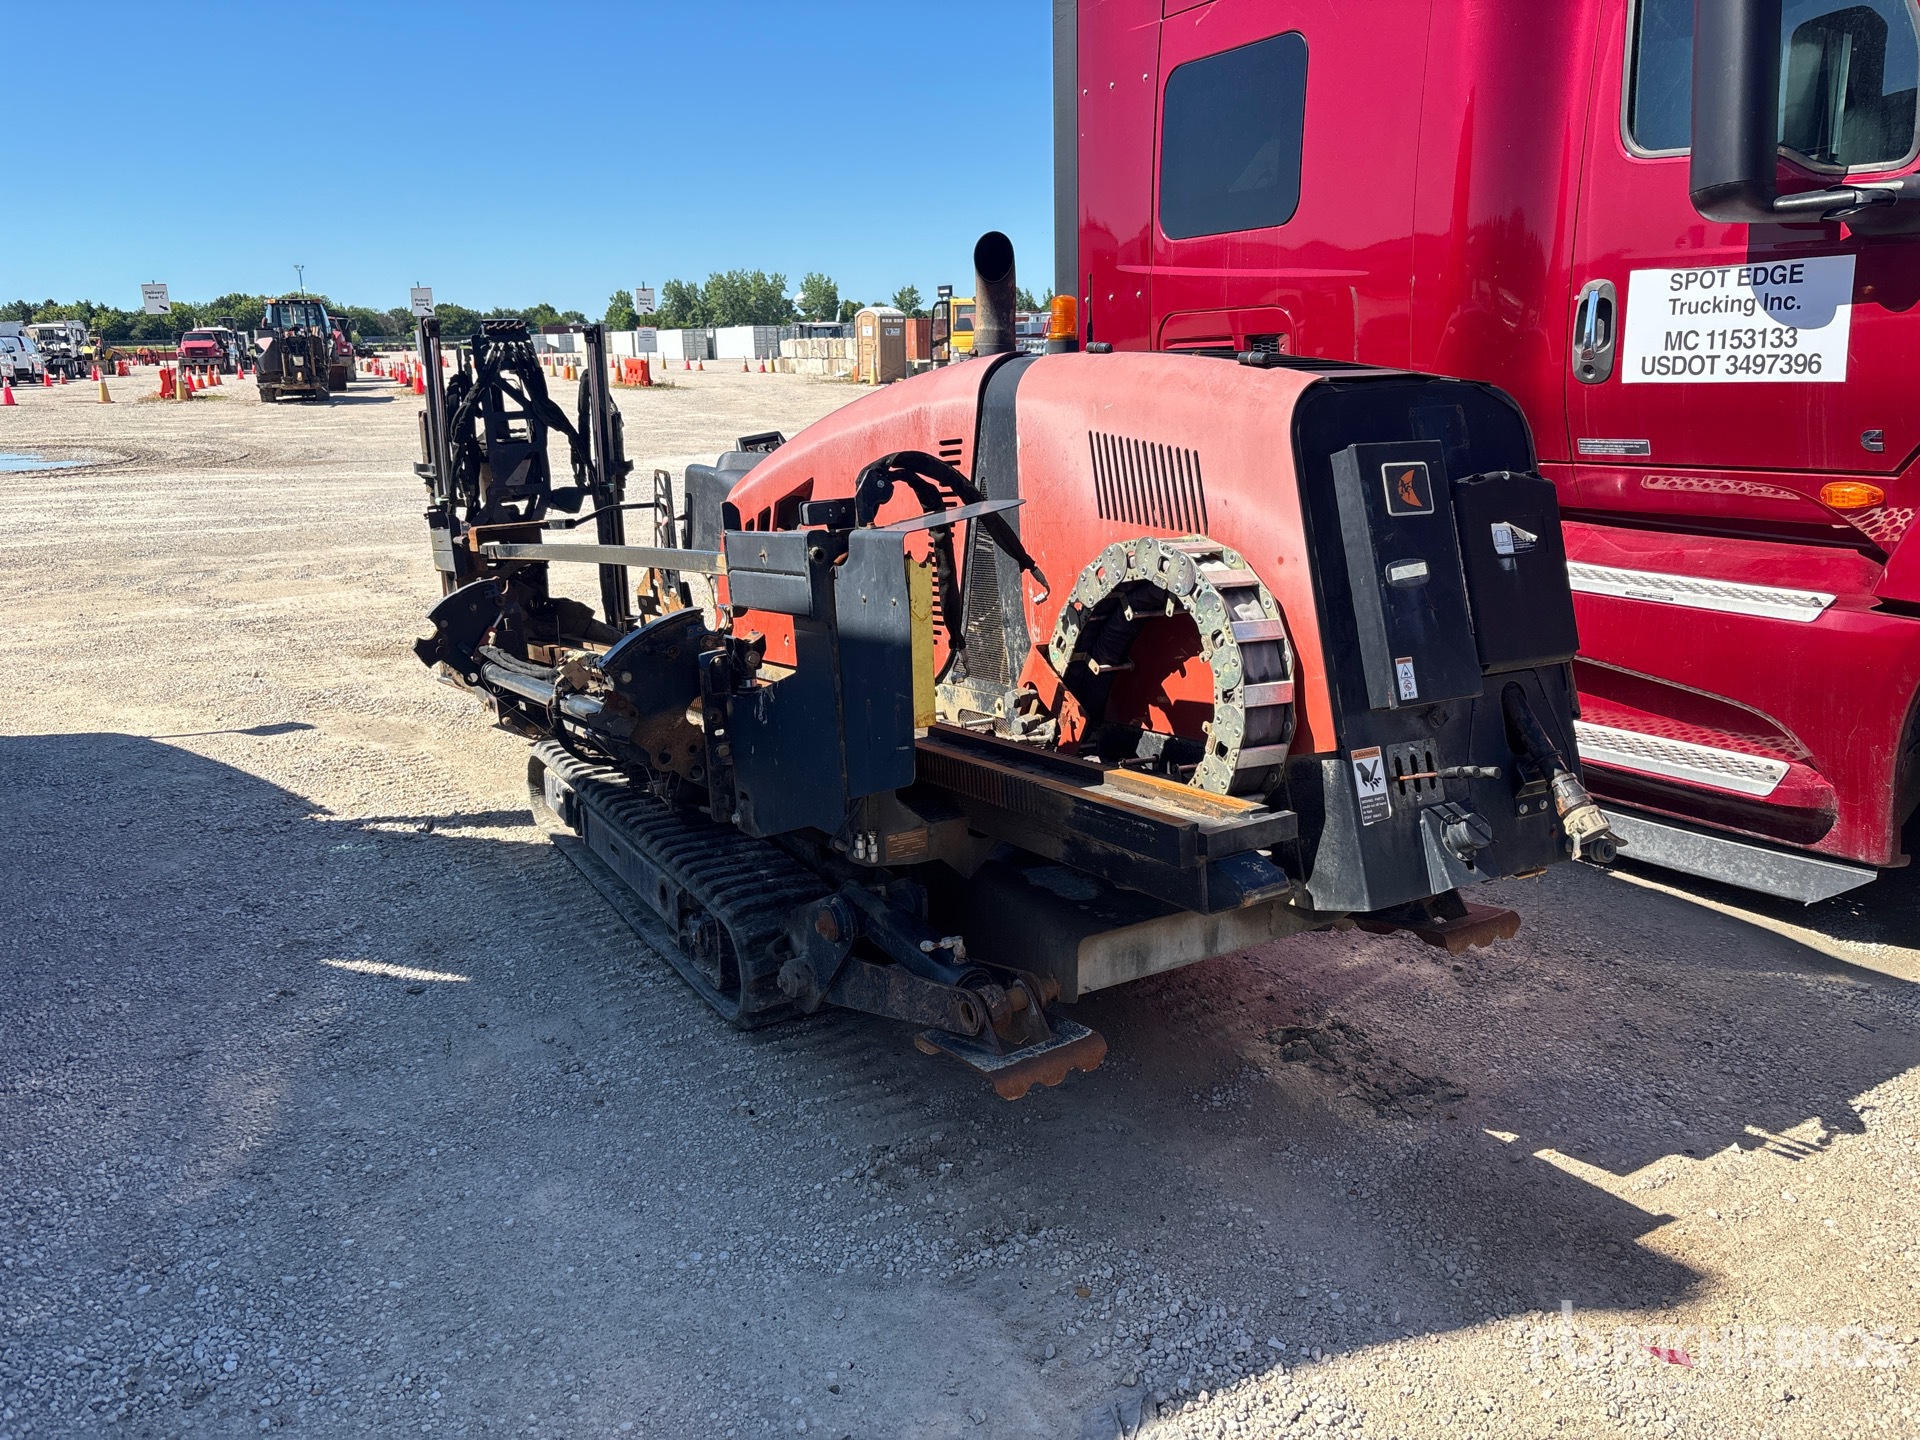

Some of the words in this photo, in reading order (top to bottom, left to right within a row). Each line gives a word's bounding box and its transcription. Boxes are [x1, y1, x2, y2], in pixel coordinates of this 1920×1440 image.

[1669, 268, 1731, 292] SPOT
[1737, 263, 1805, 287] EDGE
[1668, 295, 1756, 317] Trucking
[1763, 292, 1802, 311] Inc.
[1664, 329, 1700, 351] MC
[1706, 327, 1798, 350] 1153133
[1640, 355, 1722, 376] USDOT
[1725, 353, 1822, 375] 3497396
